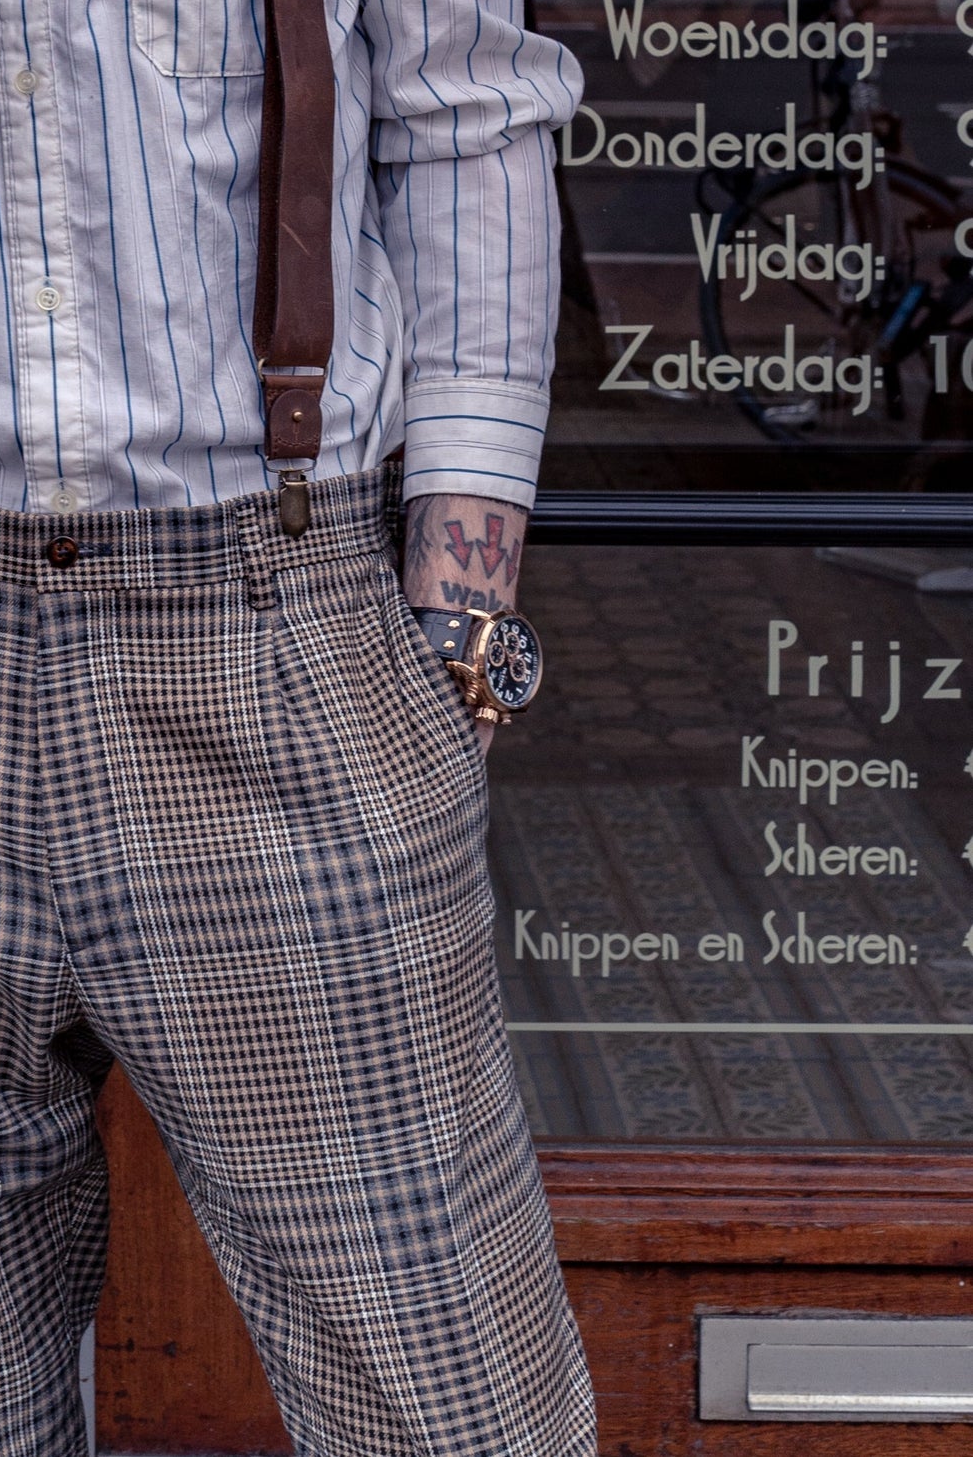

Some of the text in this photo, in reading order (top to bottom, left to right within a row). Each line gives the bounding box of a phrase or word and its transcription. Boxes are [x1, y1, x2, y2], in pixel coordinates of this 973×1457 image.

[562, 103, 886, 191] Donderdag:
[690, 213, 885, 302] Vrijdag:
[598, 324, 883, 416] Zaterdag:
[741, 735, 918, 805] Knippen:
[764, 820, 918, 877] Scheren:
[515, 909, 680, 978] Knippen
[697, 932, 744, 962] en
[762, 910, 918, 965] Scheren:
